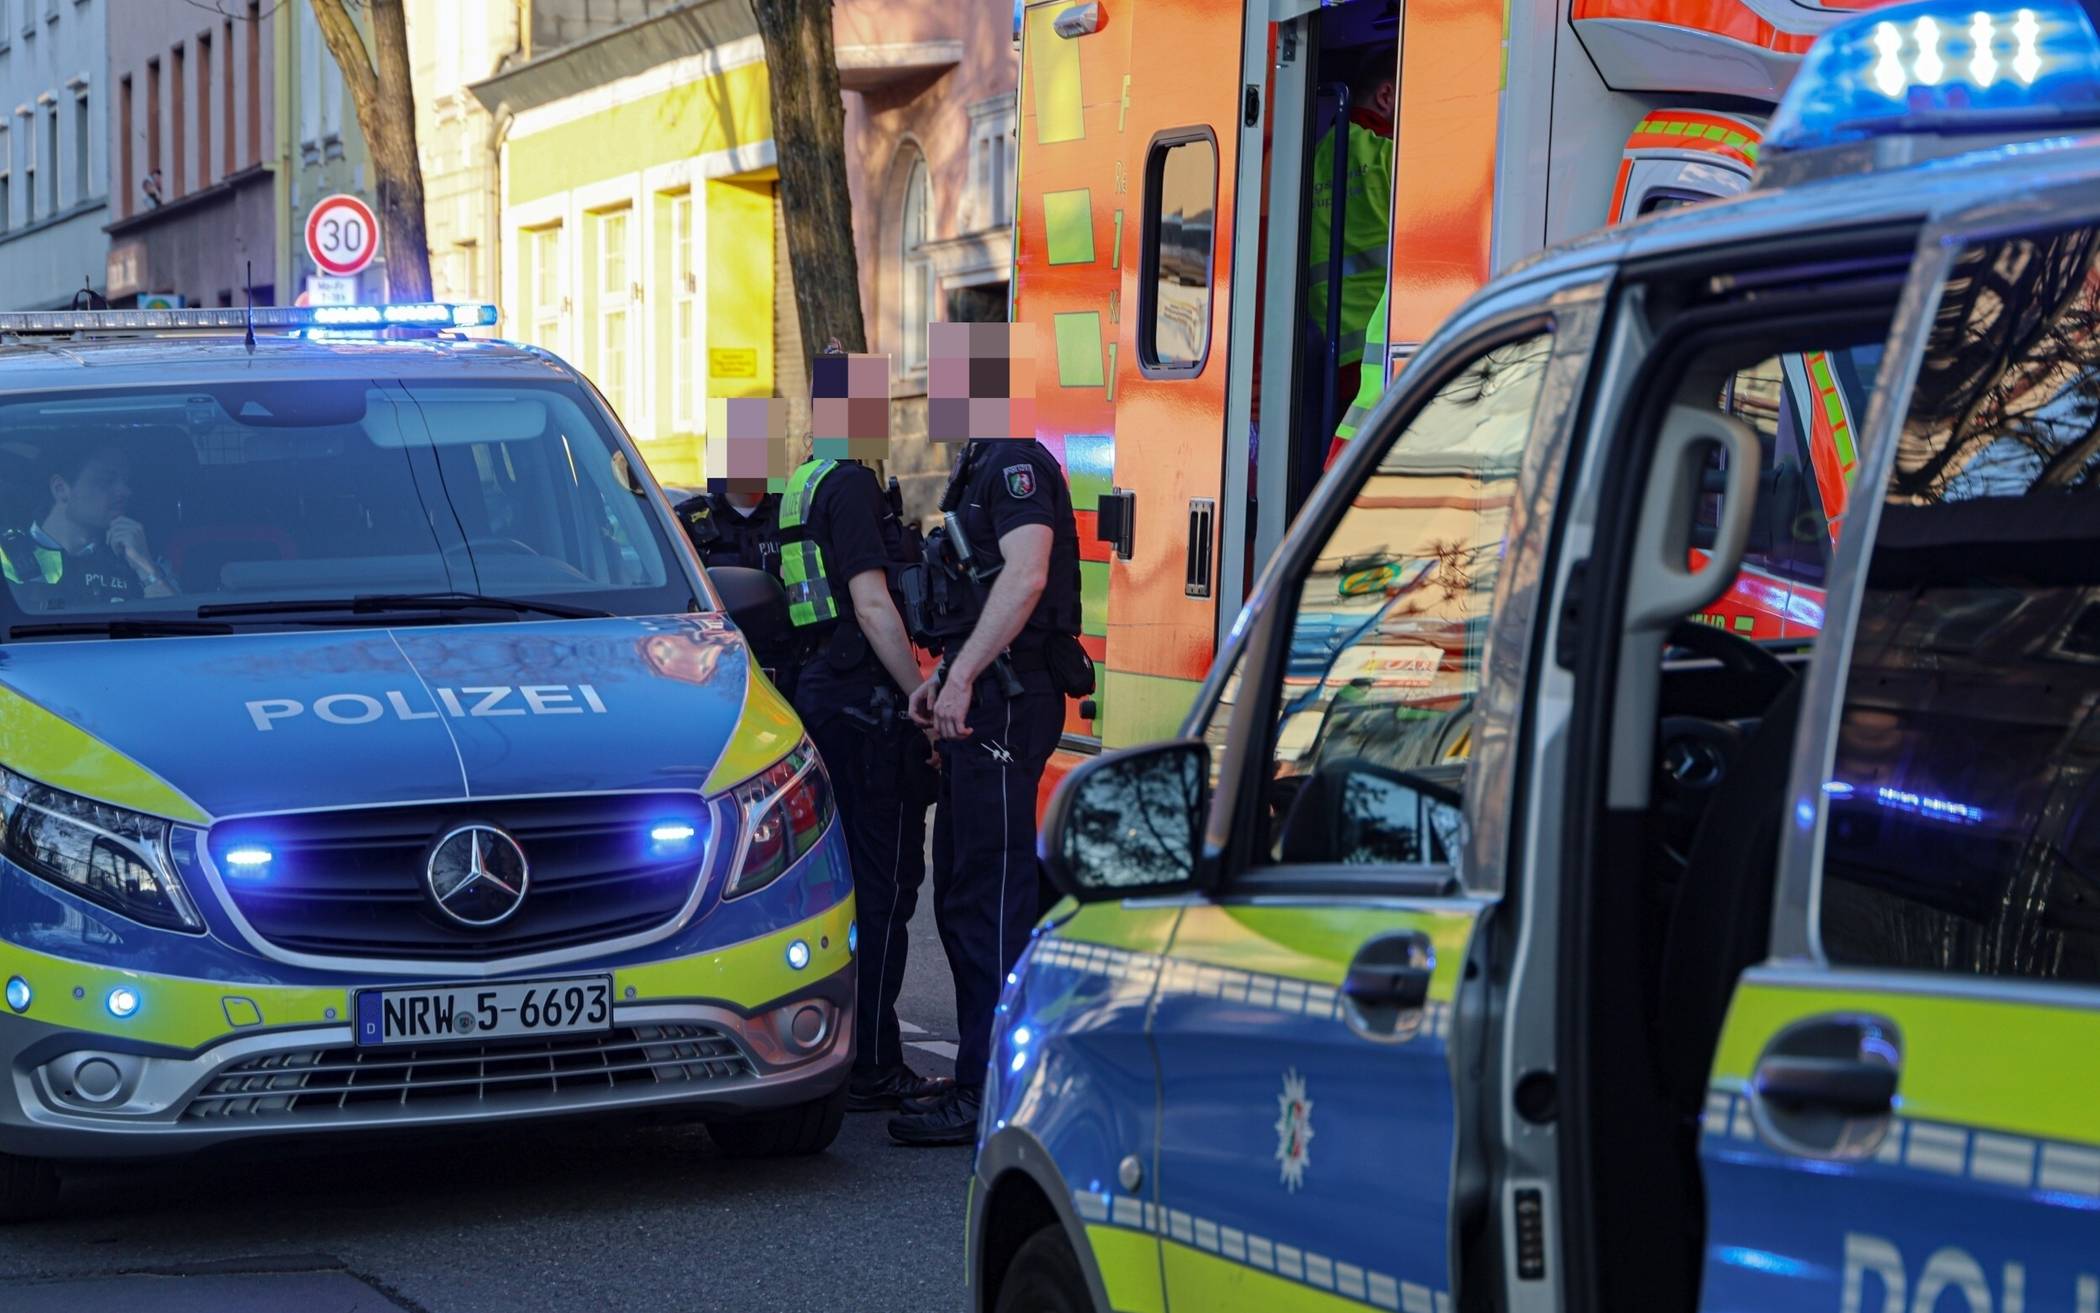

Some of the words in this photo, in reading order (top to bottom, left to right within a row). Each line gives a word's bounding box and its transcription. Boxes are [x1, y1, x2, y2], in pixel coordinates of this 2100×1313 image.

[323, 219, 361, 252] 30
[245, 684, 608, 731] POLIZEI
[366, 1022, 376, 1034] D
[384, 994, 454, 1037] NRW
[477, 985, 607, 1031] 5-6693
